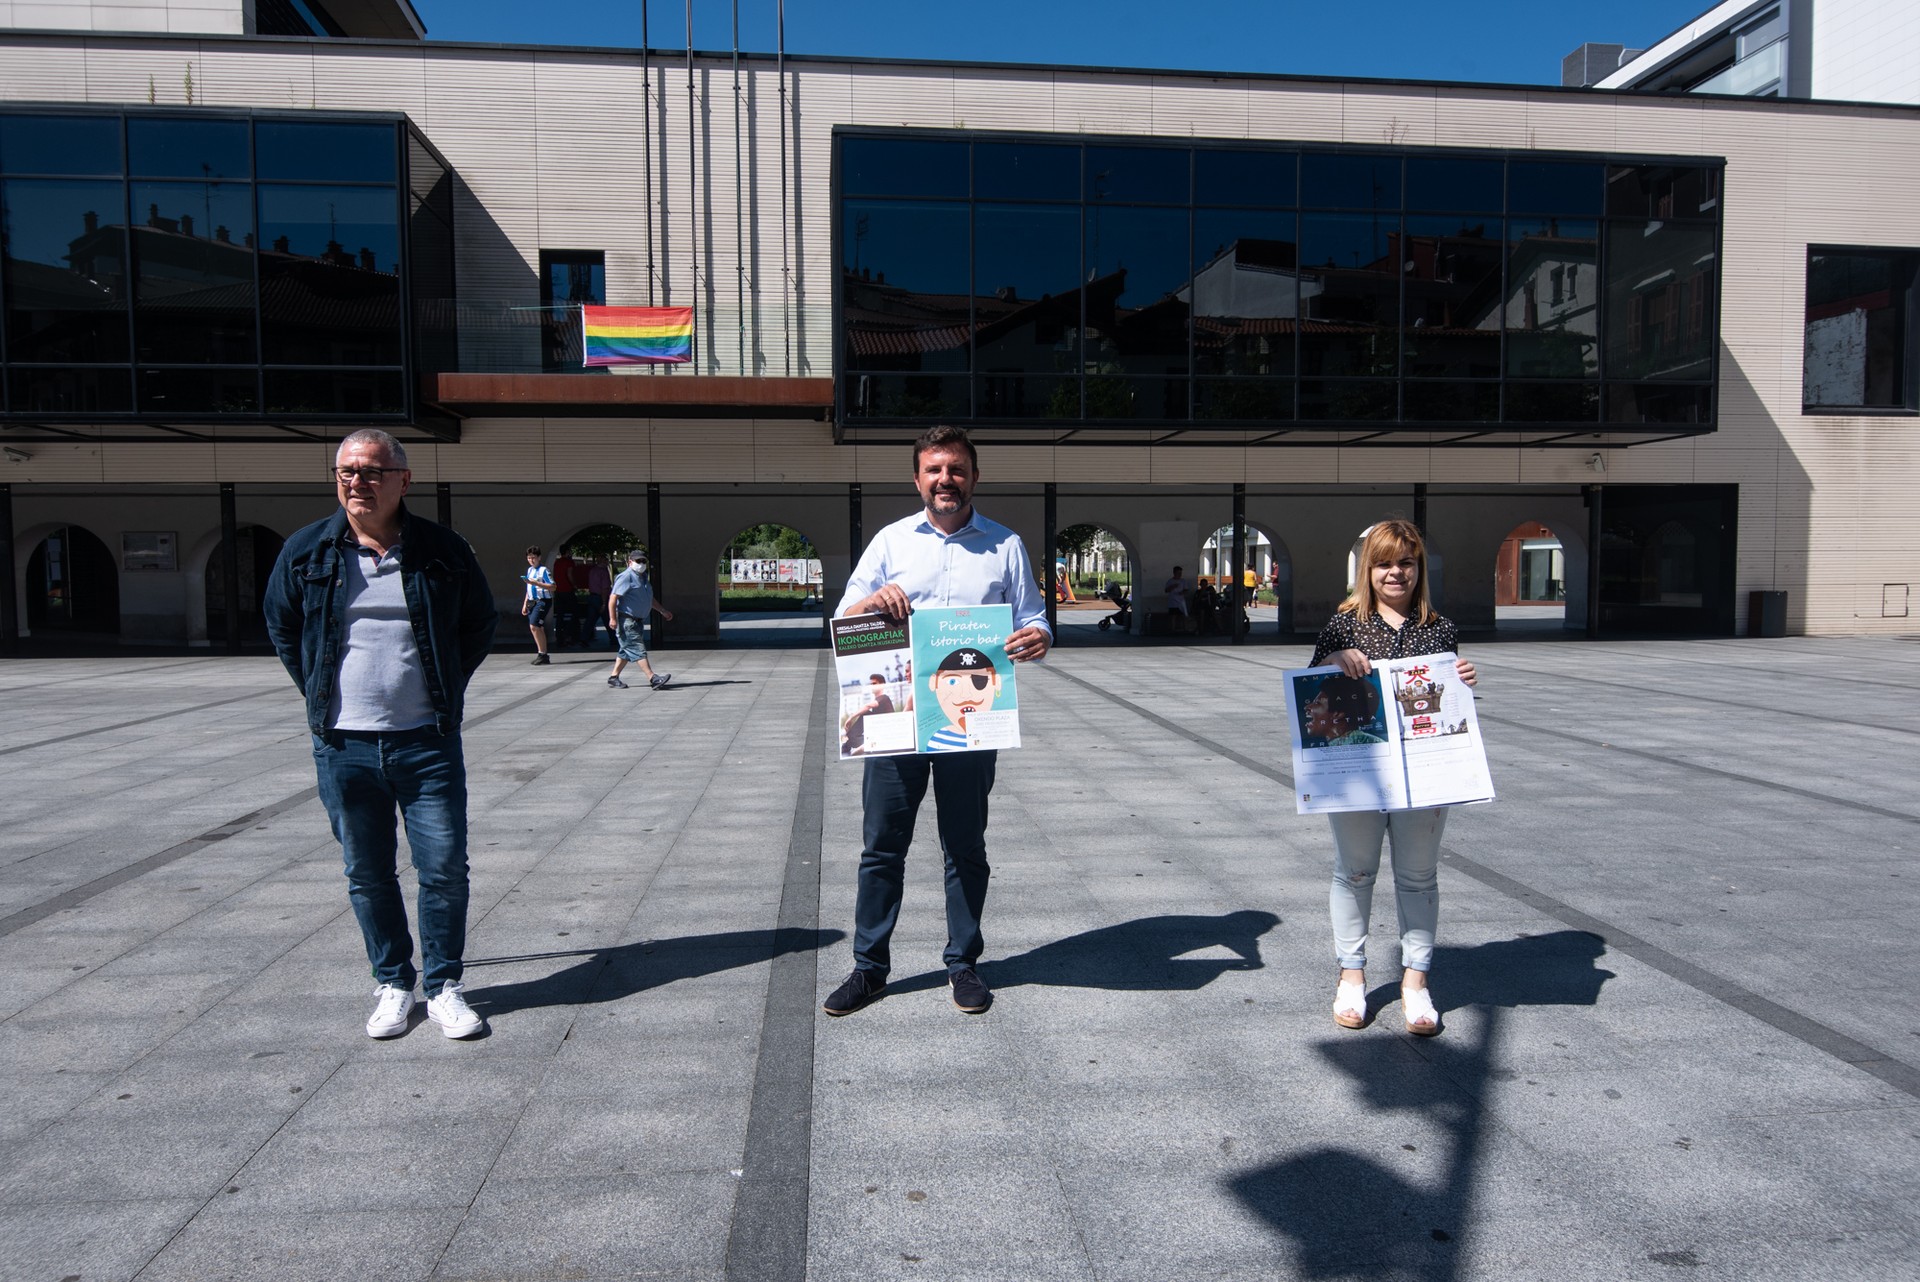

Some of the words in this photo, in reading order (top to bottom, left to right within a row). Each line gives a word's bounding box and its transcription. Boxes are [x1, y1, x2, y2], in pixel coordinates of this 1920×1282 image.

[938, 620, 990, 632] Piraten
[837, 629, 904, 646] IKONOGRAFIAK
[930, 634, 974, 647] istorio
[977, 633, 1001, 645] bat
